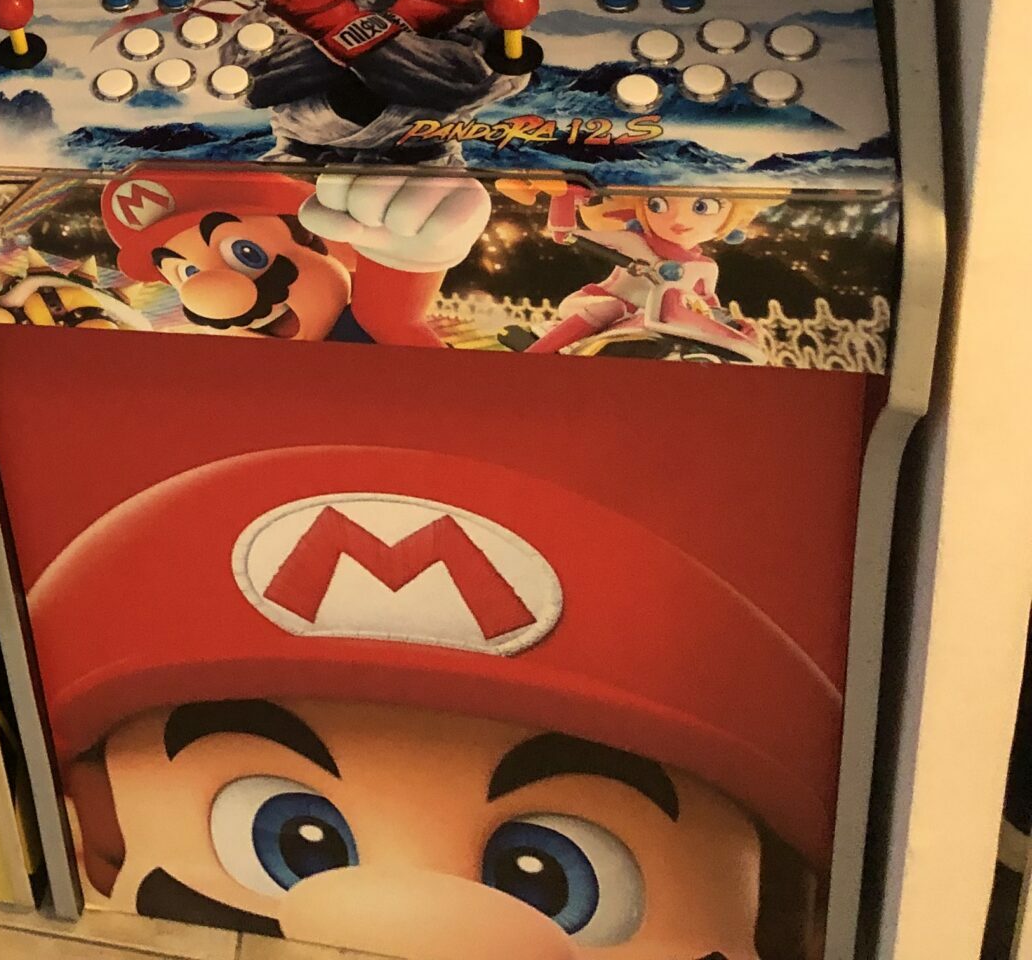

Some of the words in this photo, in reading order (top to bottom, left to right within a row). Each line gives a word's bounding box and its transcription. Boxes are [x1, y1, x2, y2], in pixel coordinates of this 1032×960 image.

[396, 114, 558, 151] PANDORA
[116, 183, 170, 226] M
[263, 505, 538, 641] M
